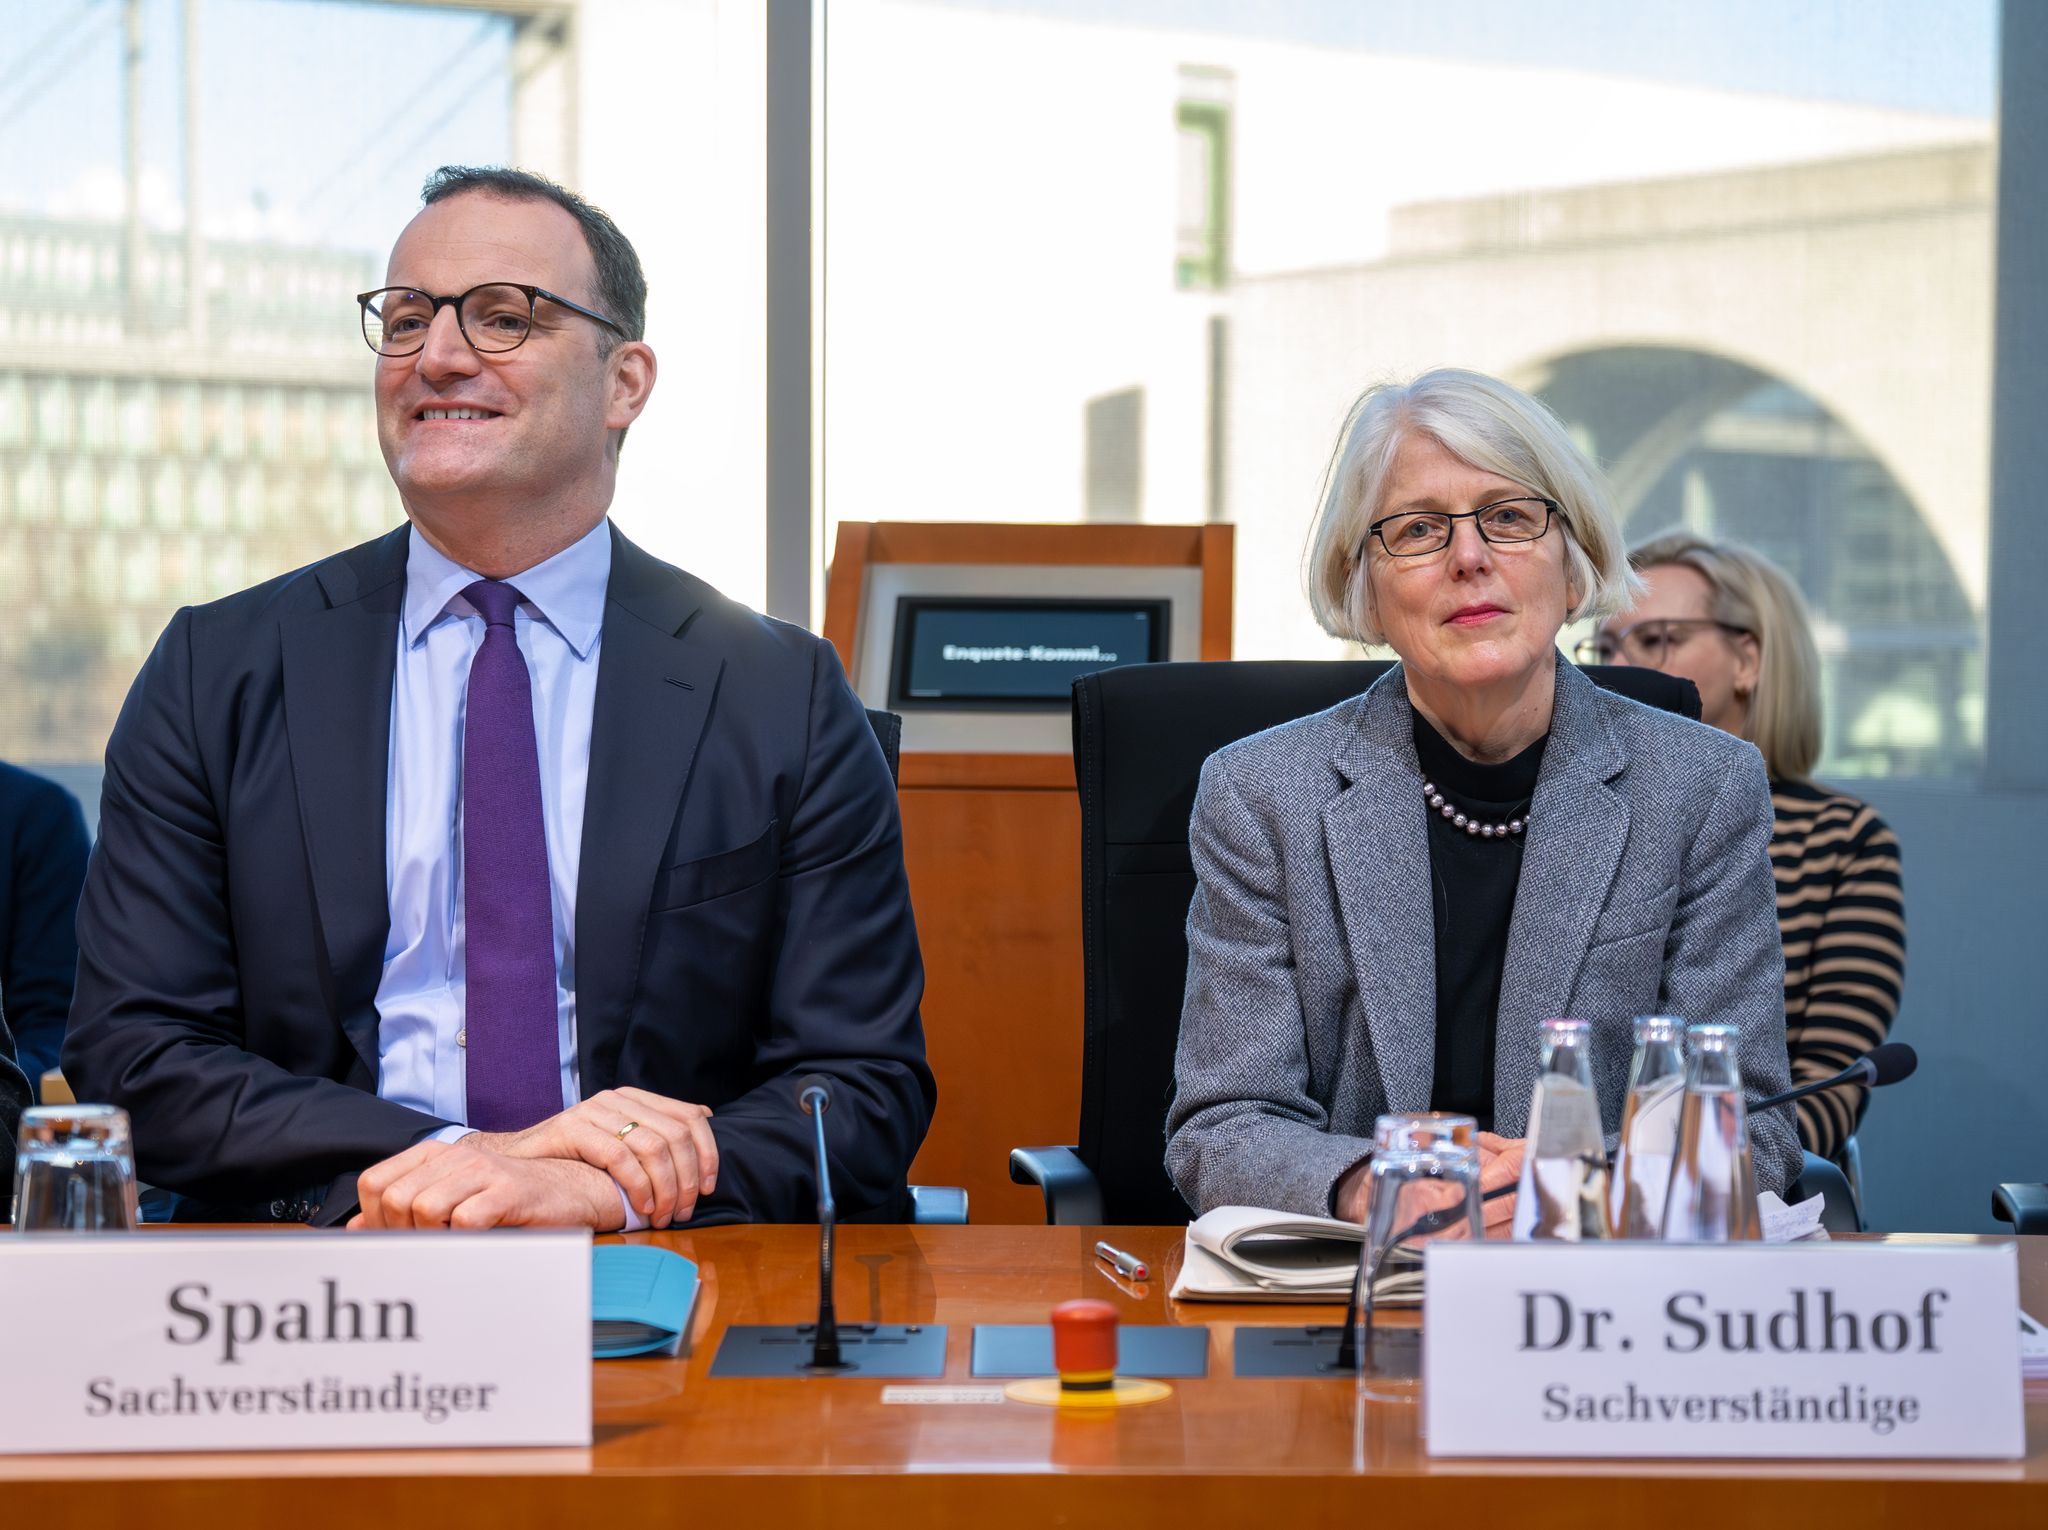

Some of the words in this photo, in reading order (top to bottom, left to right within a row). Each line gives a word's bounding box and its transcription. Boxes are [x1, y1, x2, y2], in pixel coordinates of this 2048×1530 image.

[166, 1279, 417, 1363] Spahn
[1519, 1292, 1633, 1352] Dr.
[1664, 1288, 1950, 1354] Sudhof
[86, 1374, 497, 1422] Sachverständiger
[1542, 1383, 1920, 1434] Sachverständige
